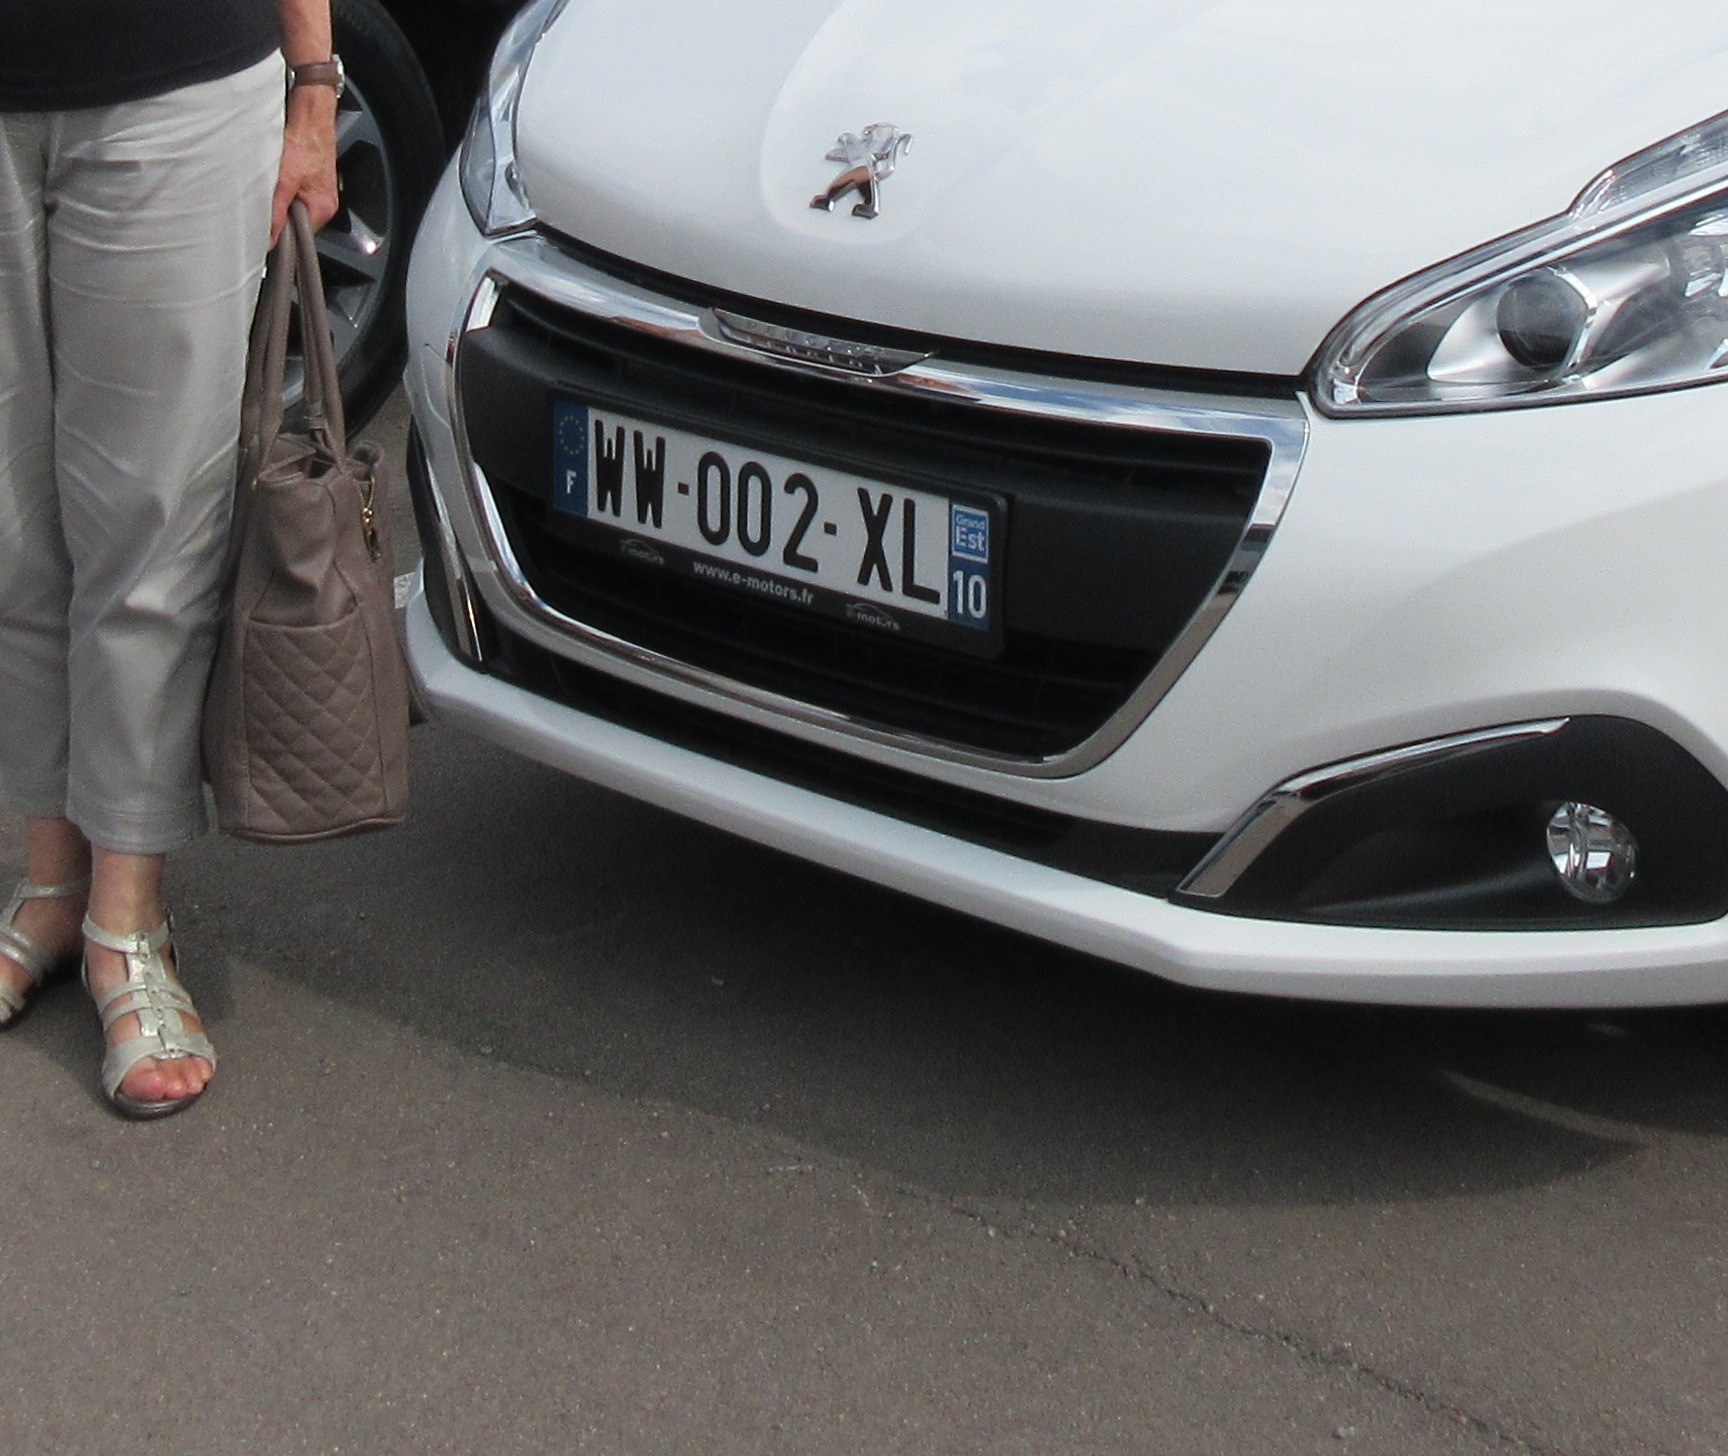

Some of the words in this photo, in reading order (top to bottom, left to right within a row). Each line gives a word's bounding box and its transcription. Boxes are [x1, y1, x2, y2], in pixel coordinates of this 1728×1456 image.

[593, 419, 942, 606] WW-002-XL
[955, 513, 986, 531] Grand
[955, 526, 985, 552] Est
[692, 561, 814, 605] www.e-motors.fr
[952, 570, 987, 619] 10
